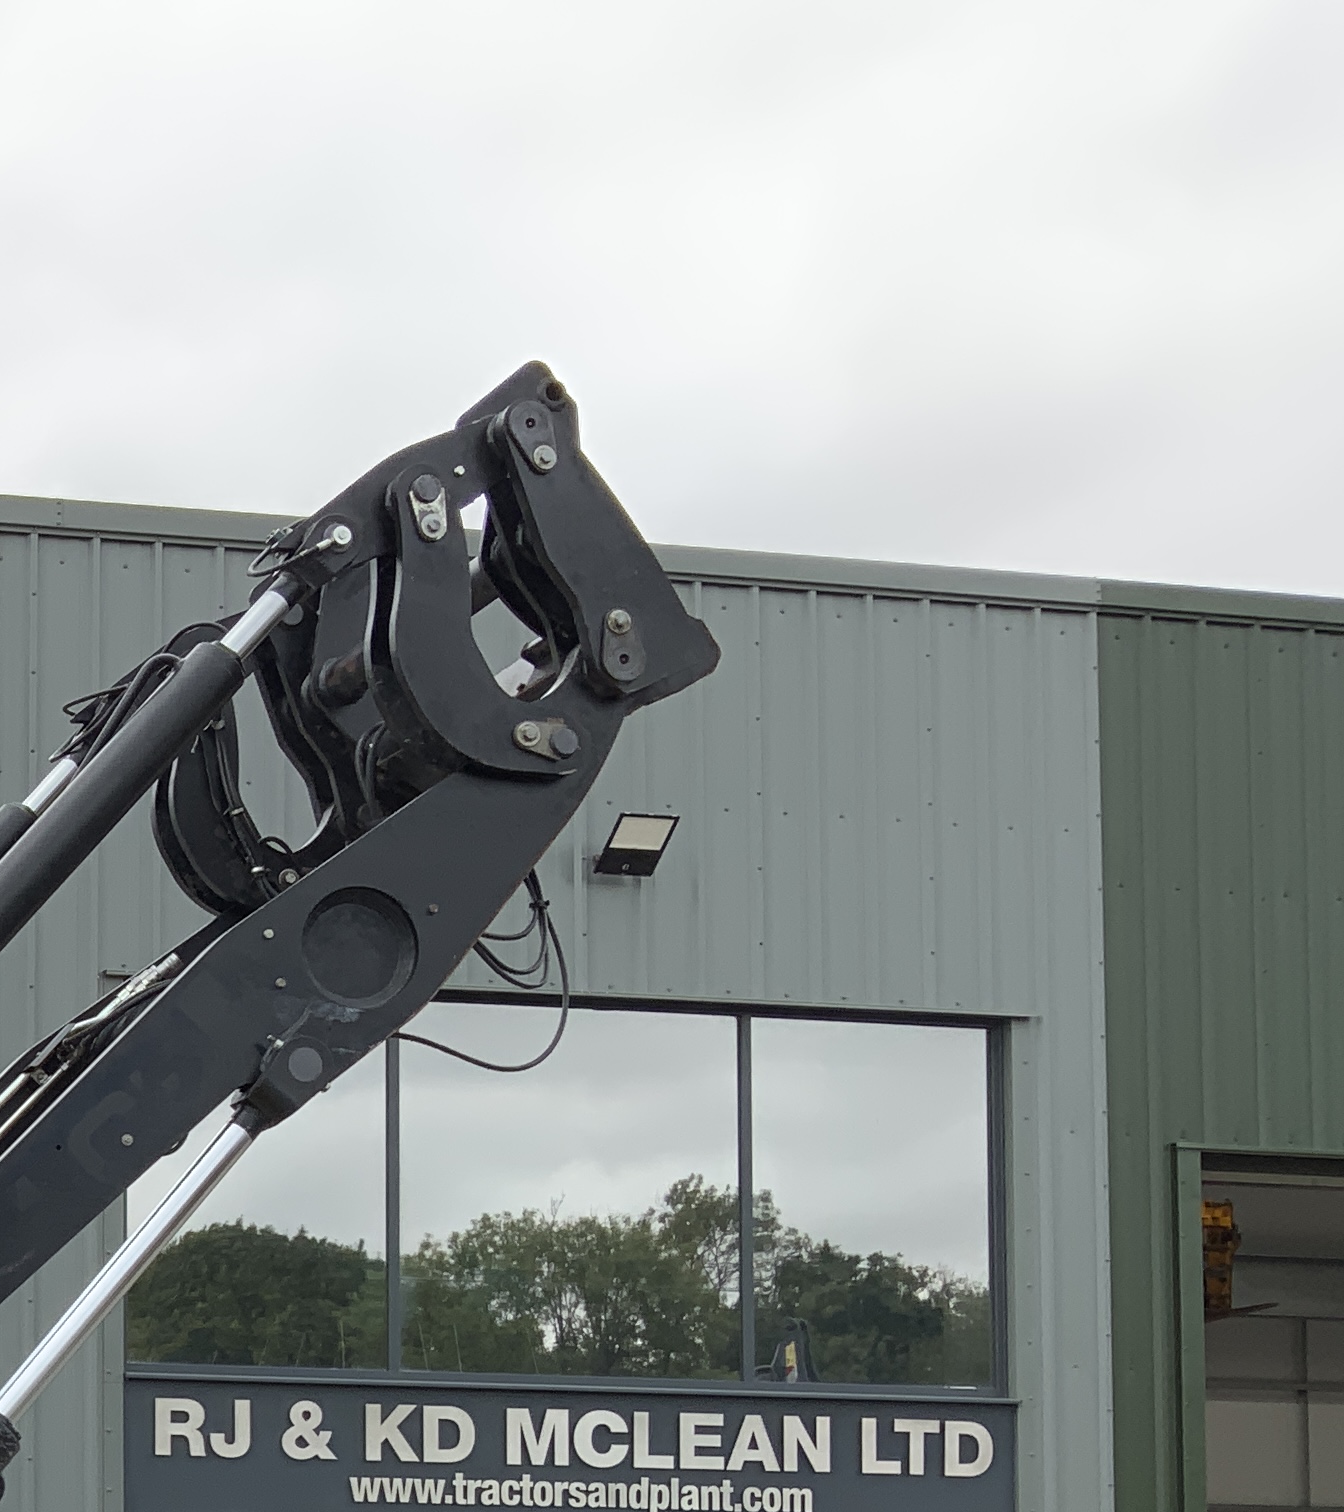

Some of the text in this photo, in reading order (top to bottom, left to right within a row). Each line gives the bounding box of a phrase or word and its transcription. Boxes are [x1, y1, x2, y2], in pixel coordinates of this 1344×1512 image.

[154, 1397, 994, 1478] RJ & KD MCLEAN LTD
